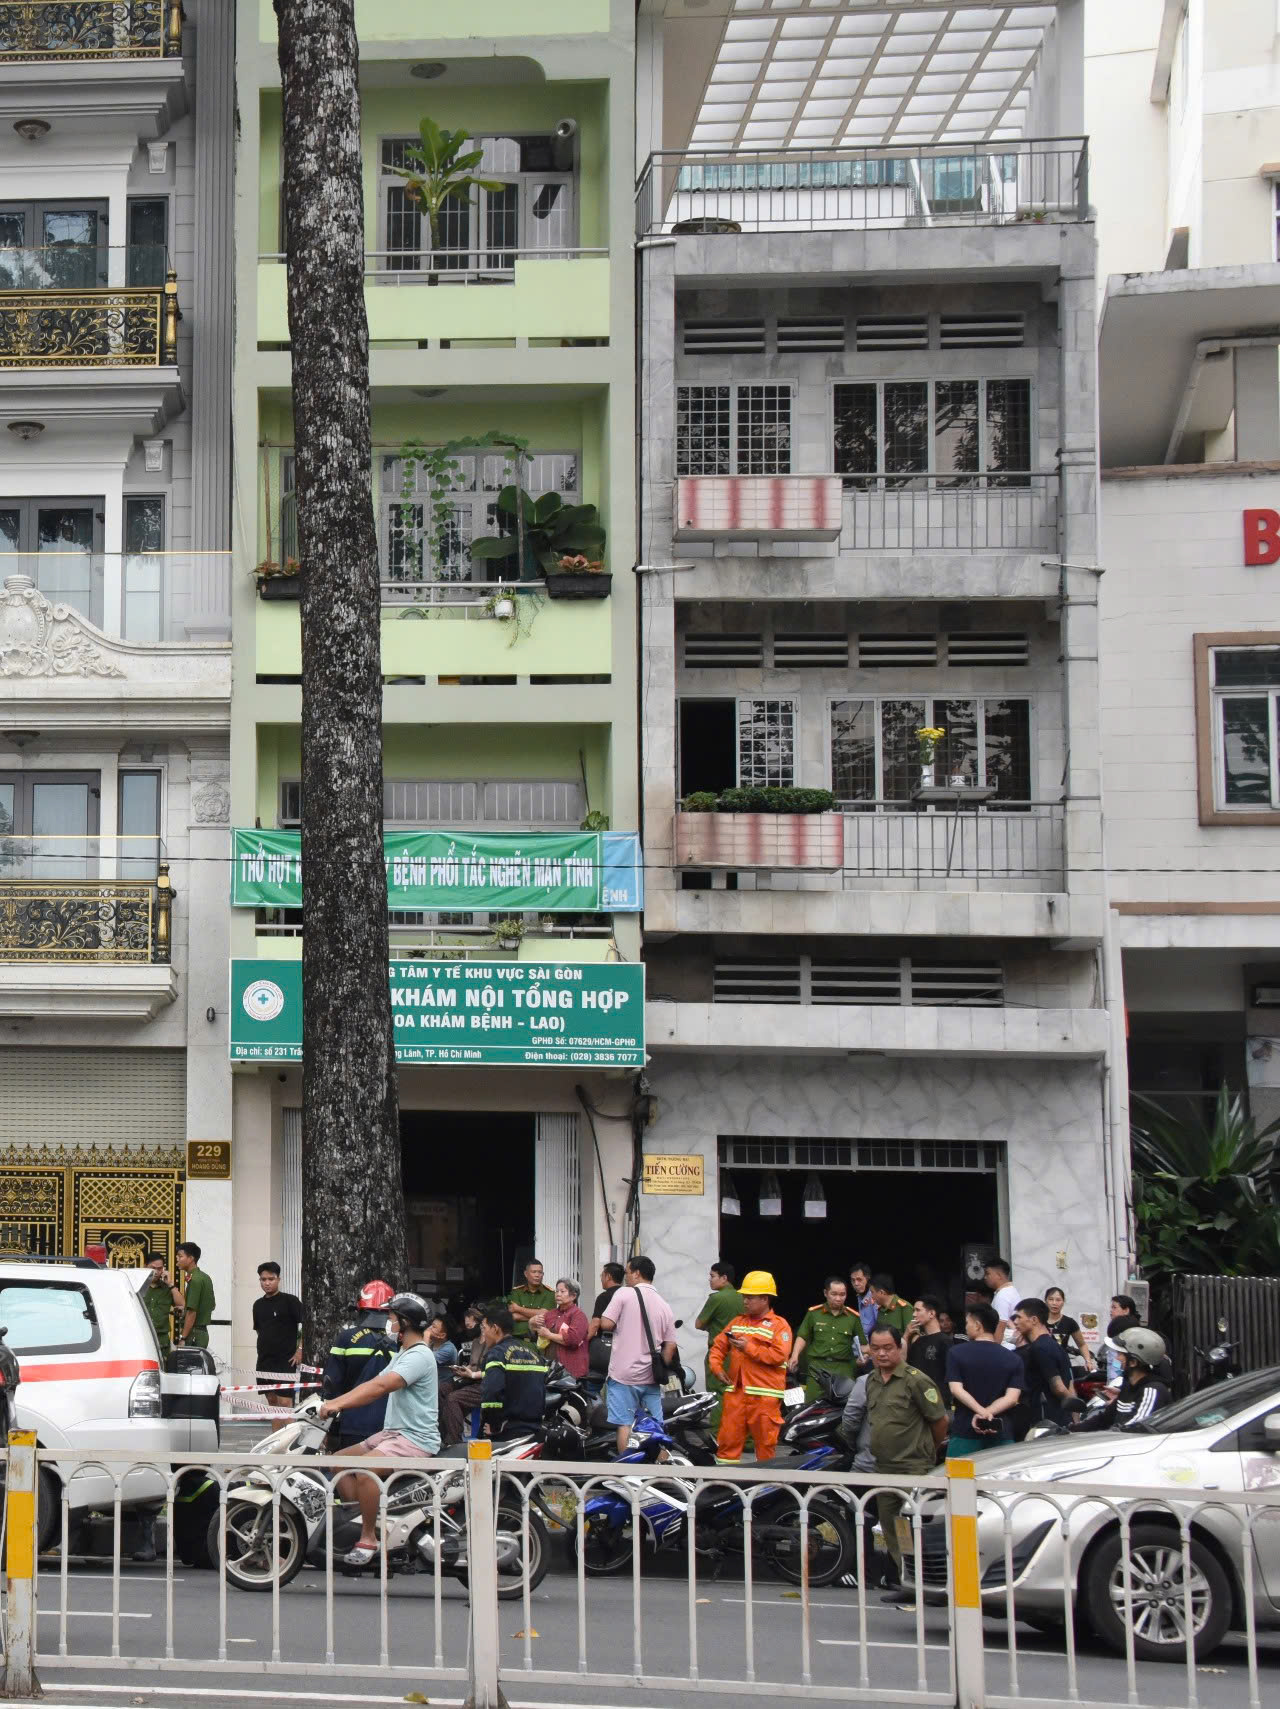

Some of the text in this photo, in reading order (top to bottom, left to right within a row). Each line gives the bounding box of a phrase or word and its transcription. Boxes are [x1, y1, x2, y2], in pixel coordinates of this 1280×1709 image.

[1243, 508, 1280, 566] B
[240, 841, 265, 883] THỞ
[268, 853, 292, 889] HỤT
[393, 848, 426, 892] BỆNH
[430, 841, 459, 887] PHỔI
[463, 844, 486, 887] TẮC
[489, 850, 531, 888] NGHẼN
[534, 858, 561, 894] MẠN
[565, 850, 593, 888] TÍNH
[400, 965, 428, 978] TÂM
[432, 967, 441, 978] Y
[445, 965, 462, 978] TẾ
[465, 967, 493, 979] KHU
[496, 968, 524, 981] VỰC
[528, 966, 550, 980] SÀI
[554, 966, 583, 980] GÒN
[391, 982, 630, 1013] KHÁM NỘI TỔNG HỢP
[420, 1012, 465, 1028] KHÁM
[470, 1012, 513, 1032] BỆNH
[530, 1016, 566, 1033] LAO)
[235, 1046, 248, 1057] Địa
[249, 1046, 263, 1056] chỉ:
[264, 1046, 273, 1056] số
[274, 1047, 287, 1056] 231
[425, 1049, 437, 1058] TP.
[438, 1048, 449, 1058] Hồ
[450, 1049, 463, 1059] Chí
[463, 1049, 482, 1059] Minh
[525, 1051, 637, 1062] Điện thoại: (028) 3836 7077
[196, 1145, 222, 1157] 229
[645, 1161, 701, 1176] TIẾN CƯỜNG
